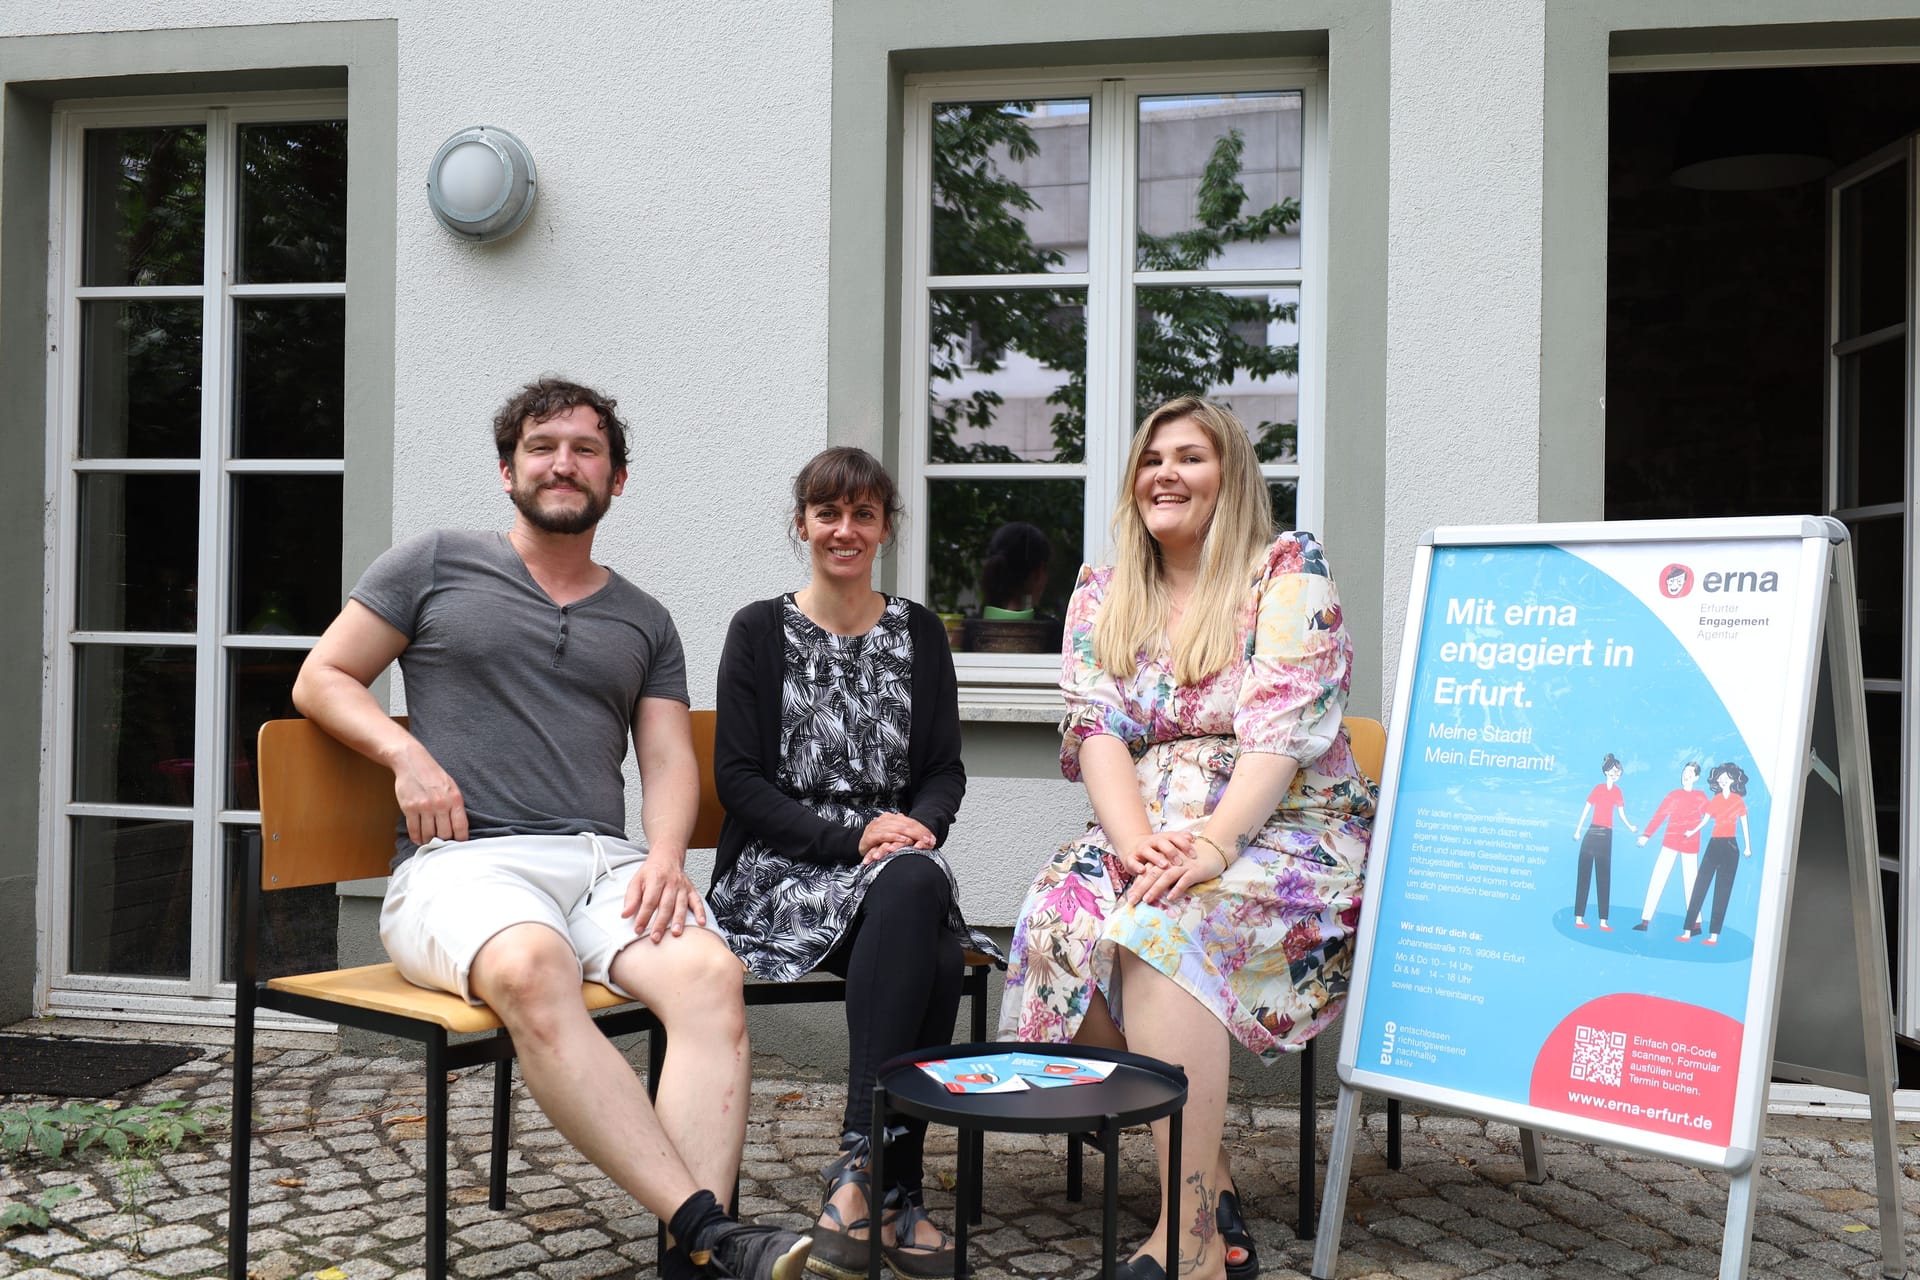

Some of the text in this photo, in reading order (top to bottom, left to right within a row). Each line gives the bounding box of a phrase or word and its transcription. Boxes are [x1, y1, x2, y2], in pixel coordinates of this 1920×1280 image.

[1703, 571, 1779, 593] erna
[1446, 598, 1577, 626] Mit erna
[1700, 603, 1738, 613] Erfurter
[1699, 617, 1769, 628] Engagement
[1697, 629, 1738, 641] Agentur
[1440, 636, 1634, 671] engagiert in
[1434, 676, 1532, 708] Erfurt.
[1428, 722, 1533, 744] Meine Stadt!
[1424, 746, 1555, 771] Mein Ehrenamt!
[1417, 807, 1430, 816] Wir
[1431, 809, 1452, 818] laden
[1464, 824, 1478, 833] wie
[1479, 825, 1496, 835] dich
[1413, 832, 1438, 842] eigene
[1440, 834, 1461, 844] Ideen
[1473, 839, 1524, 850] verwirklichen
[1525, 844, 1550, 853] sowie
[1411, 843, 1547, 865] Erfurt und unsere Gesellschaft aktiv
[1468, 862, 1509, 874] Vereinbare
[1510, 867, 1532, 877] einen
[1420, 880, 1436, 890] dich
[1438, 883, 1476, 895] persönlich
[1478, 888, 1509, 899] beraten
[1466, 874, 1482, 883] und
[1483, 876, 1508, 887] komm
[1400, 921, 1483, 941] Wir sind für dich da:
[1398, 937, 1456, 953] Johannesstraße
[1475, 948, 1500, 960] 99084
[1502, 952, 1526, 964] Erfurt
[1395, 952, 1408, 962] Mo
[1408, 954, 1415, 962] &
[1416, 954, 1428, 965] Do
[1430, 958, 1440, 967] 10
[1449, 960, 1457, 970] 14
[1459, 962, 1473, 972] Uhr
[1394, 964, 1402, 973] Di
[1403, 966, 1410, 975] &
[1410, 967, 1420, 976] Mi
[1429, 970, 1437, 979] 14
[1458, 974, 1472, 985] Uhr
[1391, 980, 1484, 1005] sowie nach Vereinbarung
[1380, 1021, 1396, 1065] erna
[1400, 1024, 1450, 1041] entschlossen
[1398, 1036, 1466, 1056] richtungsweisend
[1633, 1036, 1718, 1060] Einfach QR-Code
[1394, 1058, 1413, 1068] aktiv
[1630, 1062, 1694, 1081] ausfüllen und
[1632, 1049, 1721, 1073] scannen, Formular
[1629, 1073, 1701, 1096] Termin buchen.
[1568, 1090, 1712, 1130] www.erna-erfurt.de
